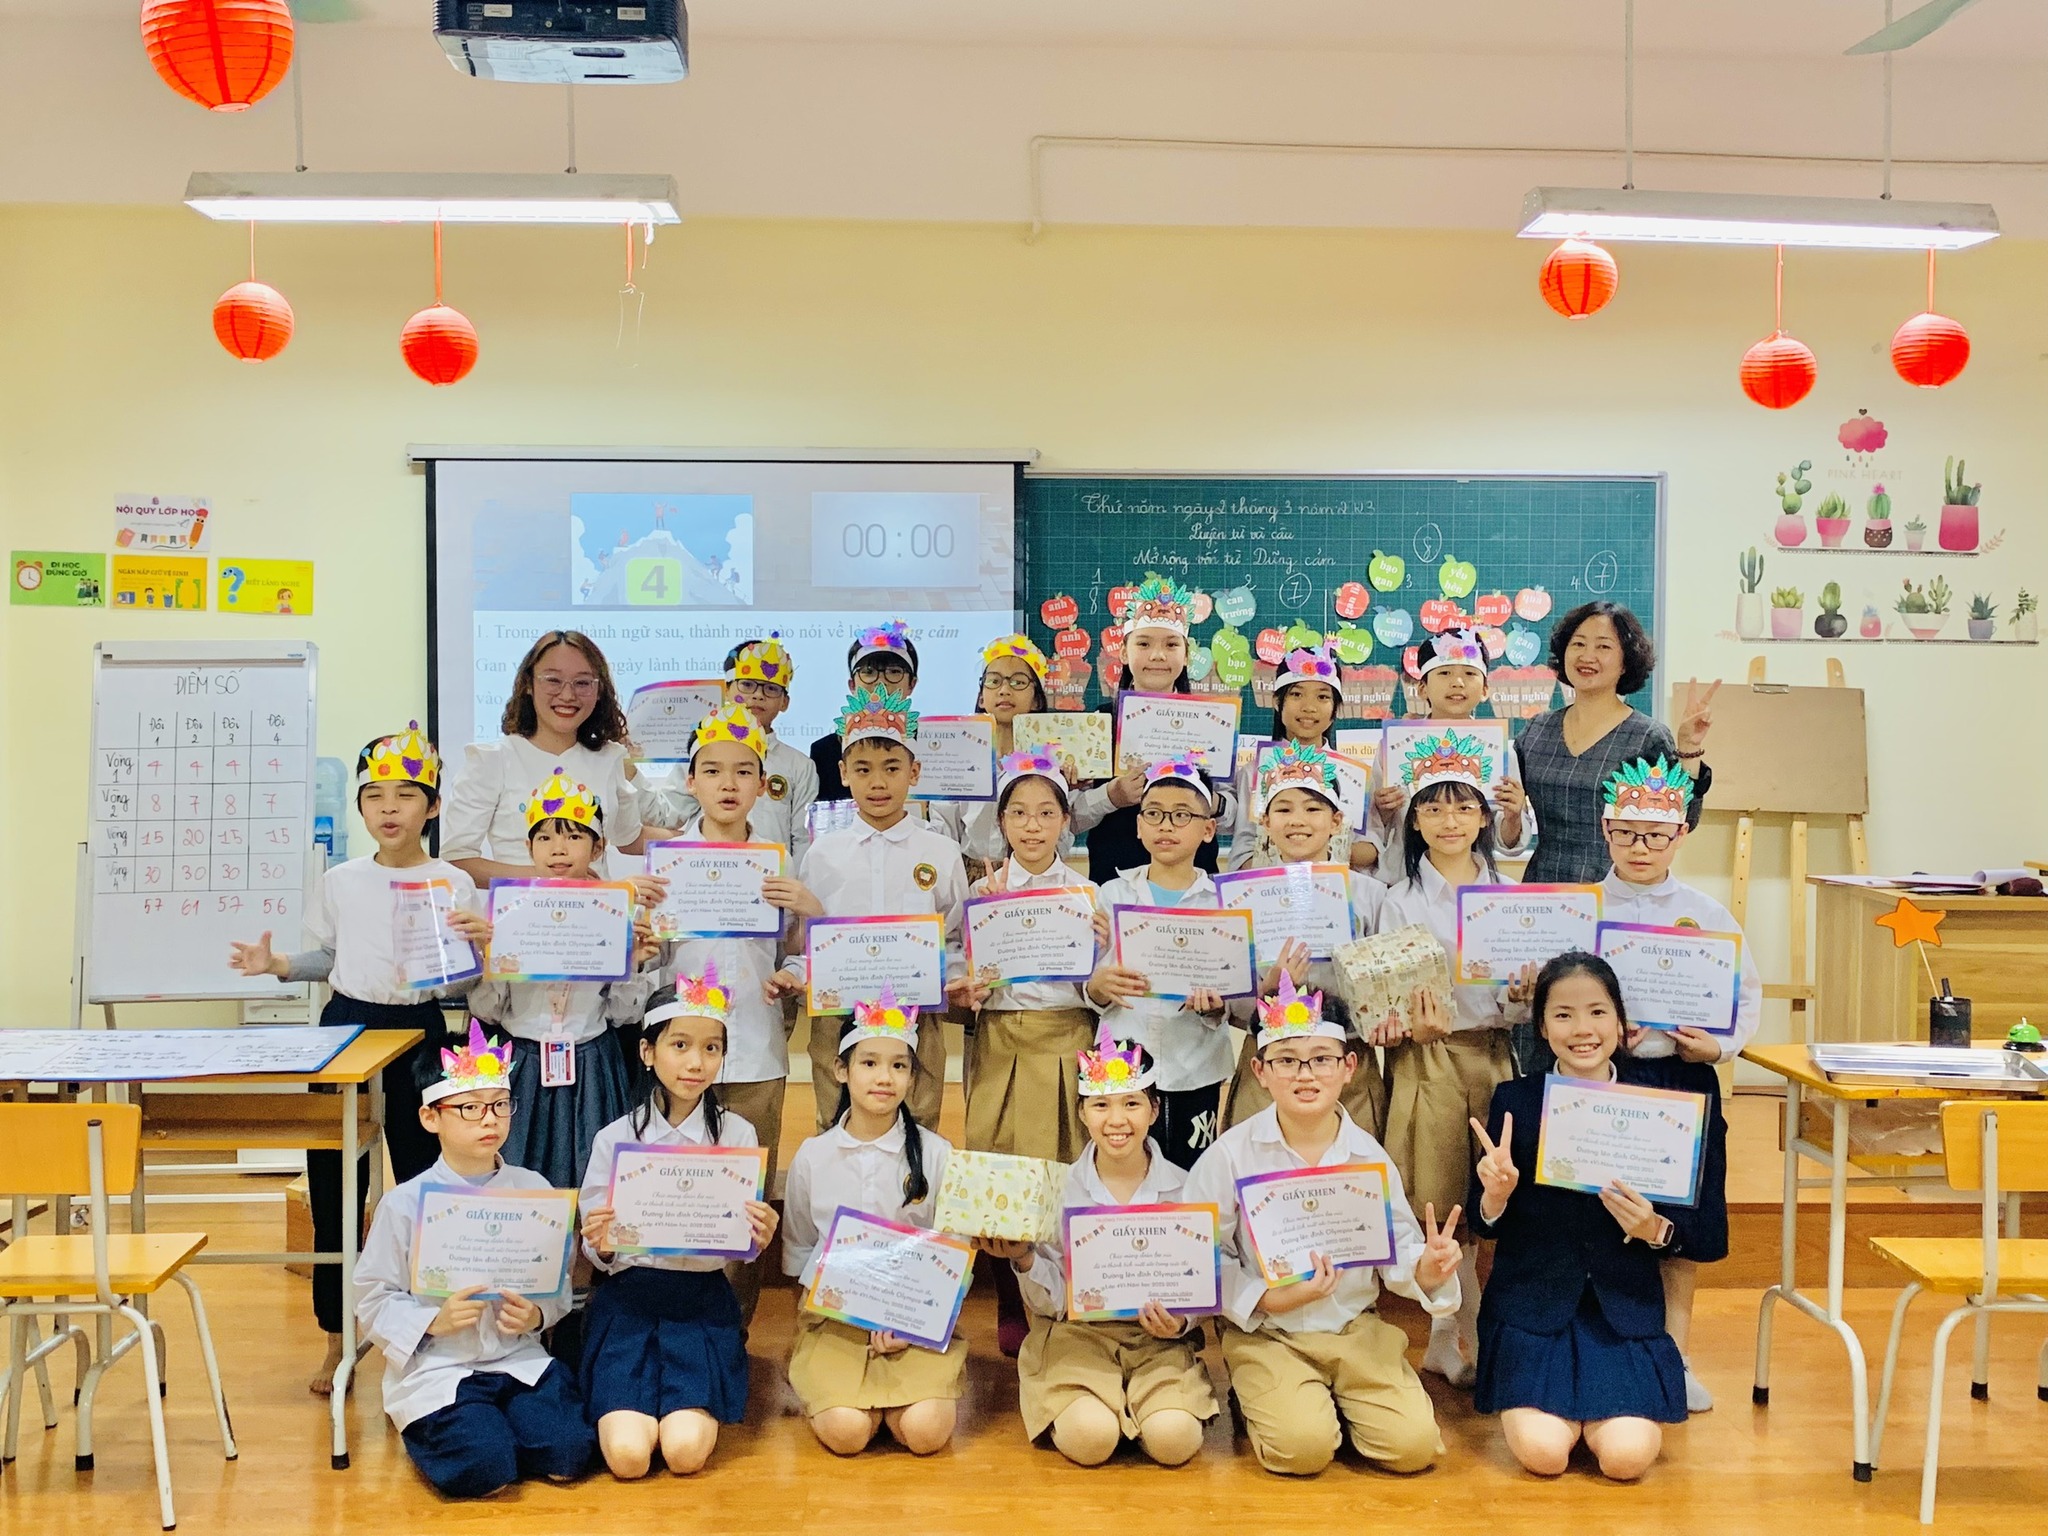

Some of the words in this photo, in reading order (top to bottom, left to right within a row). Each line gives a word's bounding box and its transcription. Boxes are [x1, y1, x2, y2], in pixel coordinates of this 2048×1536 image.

[116, 504, 133, 515] NỘI
[136, 506, 156, 515] QUY
[159, 506, 178, 515] LỚP
[1127, 498, 1167, 514] năm
[1379, 560, 1398, 574] bạo
[640, 565, 669, 599] 4
[1375, 576, 1393, 588] gan
[1226, 596, 1244, 605] can
[1430, 601, 1449, 614] bạc
[1479, 606, 1498, 615] gan
[1385, 617, 1403, 626] can
[688, 624, 731, 639] thành
[1061, 631, 1081, 642] anh
[1516, 636, 1534, 650] gan
[1227, 657, 1246, 669] bạo
[214, 667, 243, 695] SỐ
[1225, 673, 1244, 683] gan
[1362, 691, 1391, 704] nghĩa
[1492, 691, 1520, 703] Cùng
[1521, 691, 1550, 703] nghĩa
[154, 736, 160, 746] 1
[191, 733, 199, 744] 2
[228, 733, 235, 744] 3
[273, 732, 282, 745] 4
[147, 760, 163, 777] 4
[190, 760, 204, 778] 4
[225, 759, 241, 776] 4
[267, 758, 283, 774] 4
[112, 768, 119, 784] 1
[151, 793, 161, 812] 8
[189, 795, 200, 815] 7
[225, 794, 237, 815] 8
[262, 793, 277, 814] 7
[110, 804, 118, 818] 2
[141, 830, 164, 845] 15
[182, 828, 205, 847] 20
[217, 829, 243, 845] 15
[265, 827, 290, 844] 15
[259, 862, 286, 879] 30
[690, 858, 712, 869] GIẤY
[713, 860, 739, 869] KHEN
[144, 866, 161, 885] 30
[181, 864, 207, 881] 30
[222, 863, 240, 880] 30
[144, 897, 163, 914] 57
[181, 898, 200, 916] 61
[217, 895, 244, 913] 57
[263, 897, 287, 915] 56
[533, 897, 558, 909] GIẤY
[558, 900, 585, 909] KHEN
[1502, 903, 1525, 915] GIẤY
[1526, 906, 1553, 914] KHEN
[1004, 908, 1026, 919] GIẤY
[1027, 907, 1052, 916] KHEN
[1156, 924, 1178, 935] GIẤY
[1179, 927, 1205, 936] KHEN
[849, 932, 871, 944] GIẤY
[872, 934, 898, 943] KHEN
[1641, 944, 1664, 956] GIẤY
[1665, 948, 1692, 958] KHEN
[1593, 1103, 1618, 1117] GIẤY
[1620, 1108, 1650, 1120] KHEN
[659, 1165, 685, 1177] GIẤY
[686, 1169, 714, 1178] KHEN
[1282, 1188, 1307, 1201] GIẤY
[1308, 1187, 1337, 1198] KHEN
[466, 1208, 492, 1221] GIẤY
[493, 1210, 523, 1221] KHEN
[1112, 1224, 1137, 1237] GIẤY
[1138, 1226, 1167, 1236] KHEN
